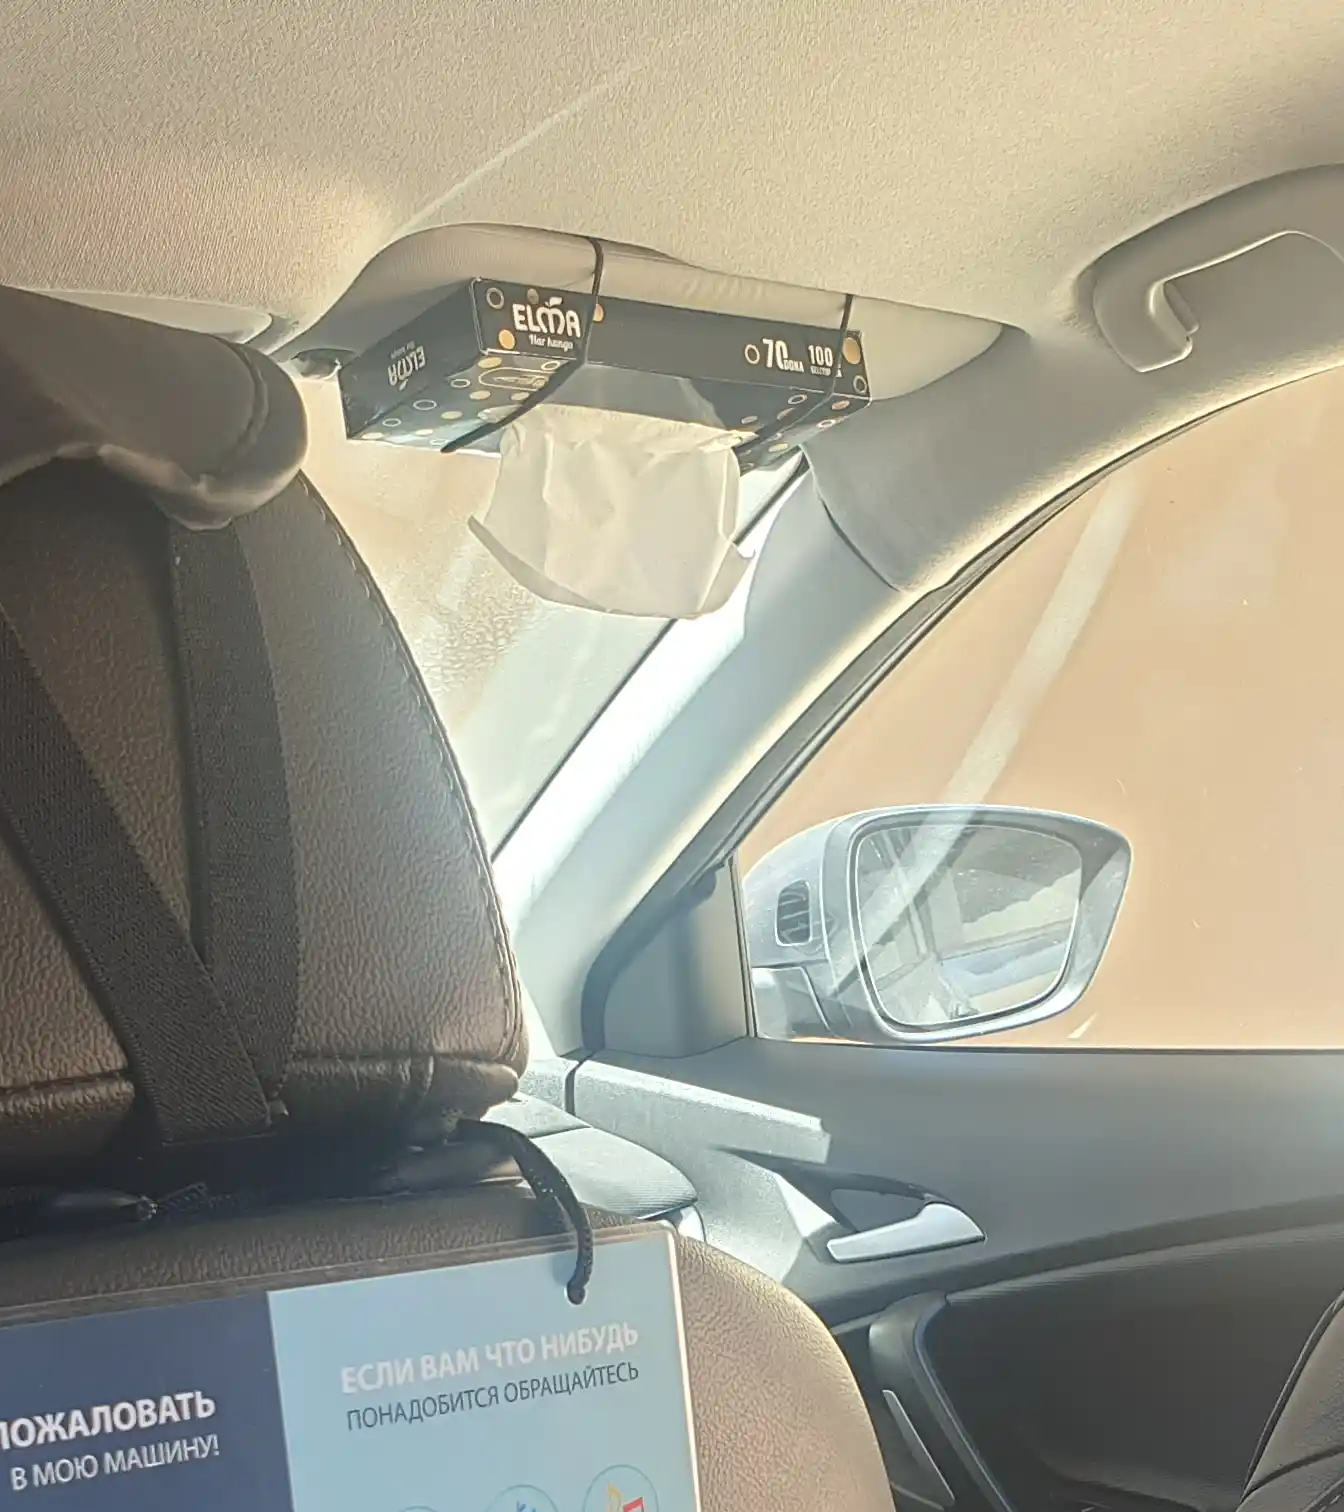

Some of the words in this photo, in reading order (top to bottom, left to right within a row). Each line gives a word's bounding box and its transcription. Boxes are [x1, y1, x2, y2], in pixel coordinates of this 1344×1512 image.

[512, 303, 580, 337] ELMA
[763, 338, 788, 369] 70
[808, 345, 833, 367] 100
[341, 1358, 414, 1394] ЕСЛИ
[421, 1346, 480, 1379] ВАМ
[485, 1337, 534, 1368] ЧТО
[540, 1322, 639, 1359] НИБУДЬ
[347, 1385, 499, 1431] ПОНАДОБИТСЯ
[504, 1362, 639, 1403] ОБРАЩАЙТЕСЬ
[11, 1468, 27, 1490] В
[33, 1455, 98, 1487] МОЮ
[104, 1434, 219, 1474] МАШИНУ!
